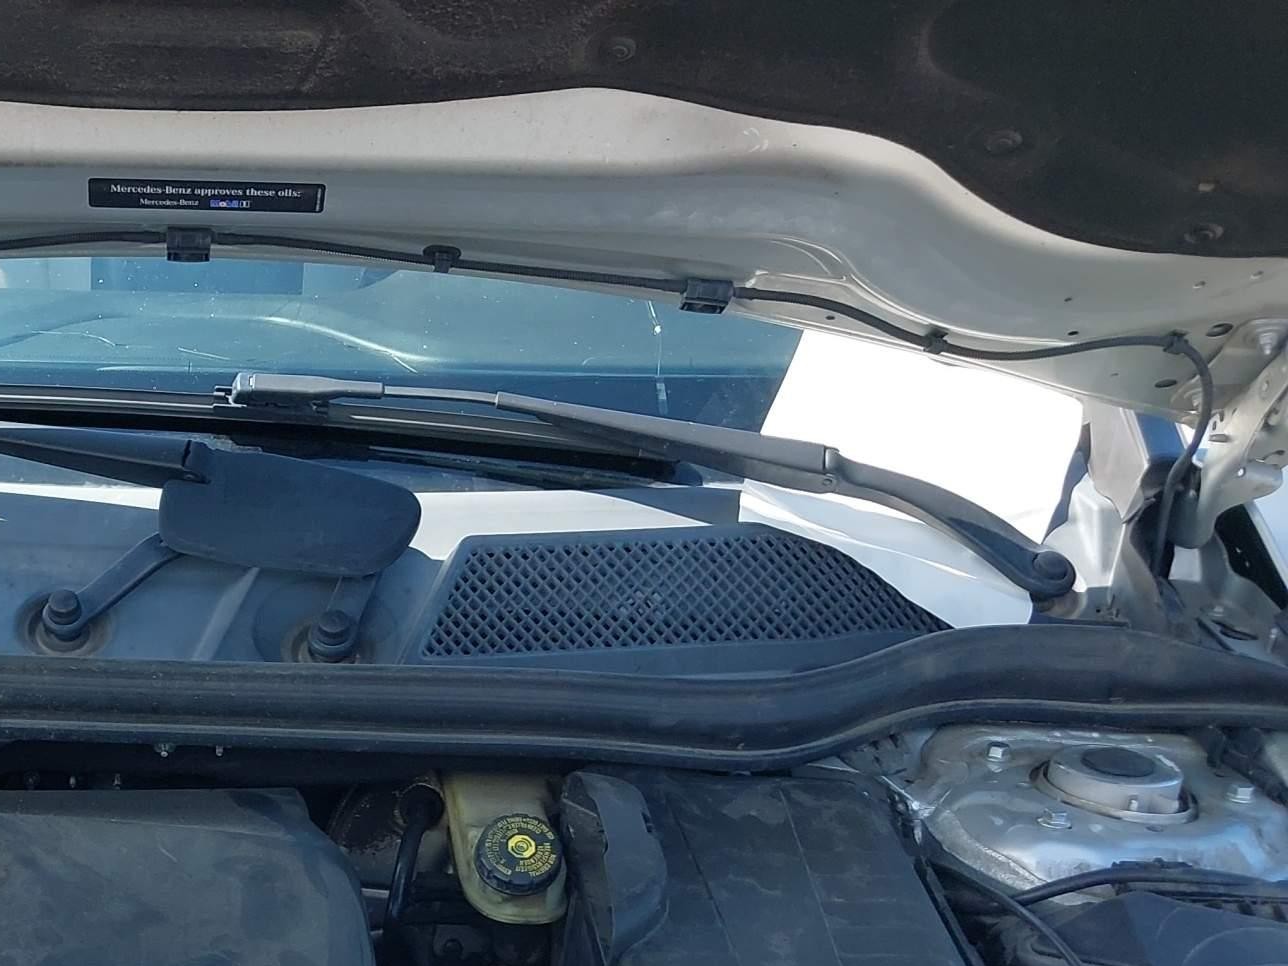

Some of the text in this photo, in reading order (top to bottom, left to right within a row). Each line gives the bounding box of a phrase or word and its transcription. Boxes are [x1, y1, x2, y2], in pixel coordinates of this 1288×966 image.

[110, 184, 192, 194] Mercedes-Benz
[194, 187, 243, 197] approves
[245, 187, 275, 197] these
[139, 198, 199, 206] Mercedes-Benz
